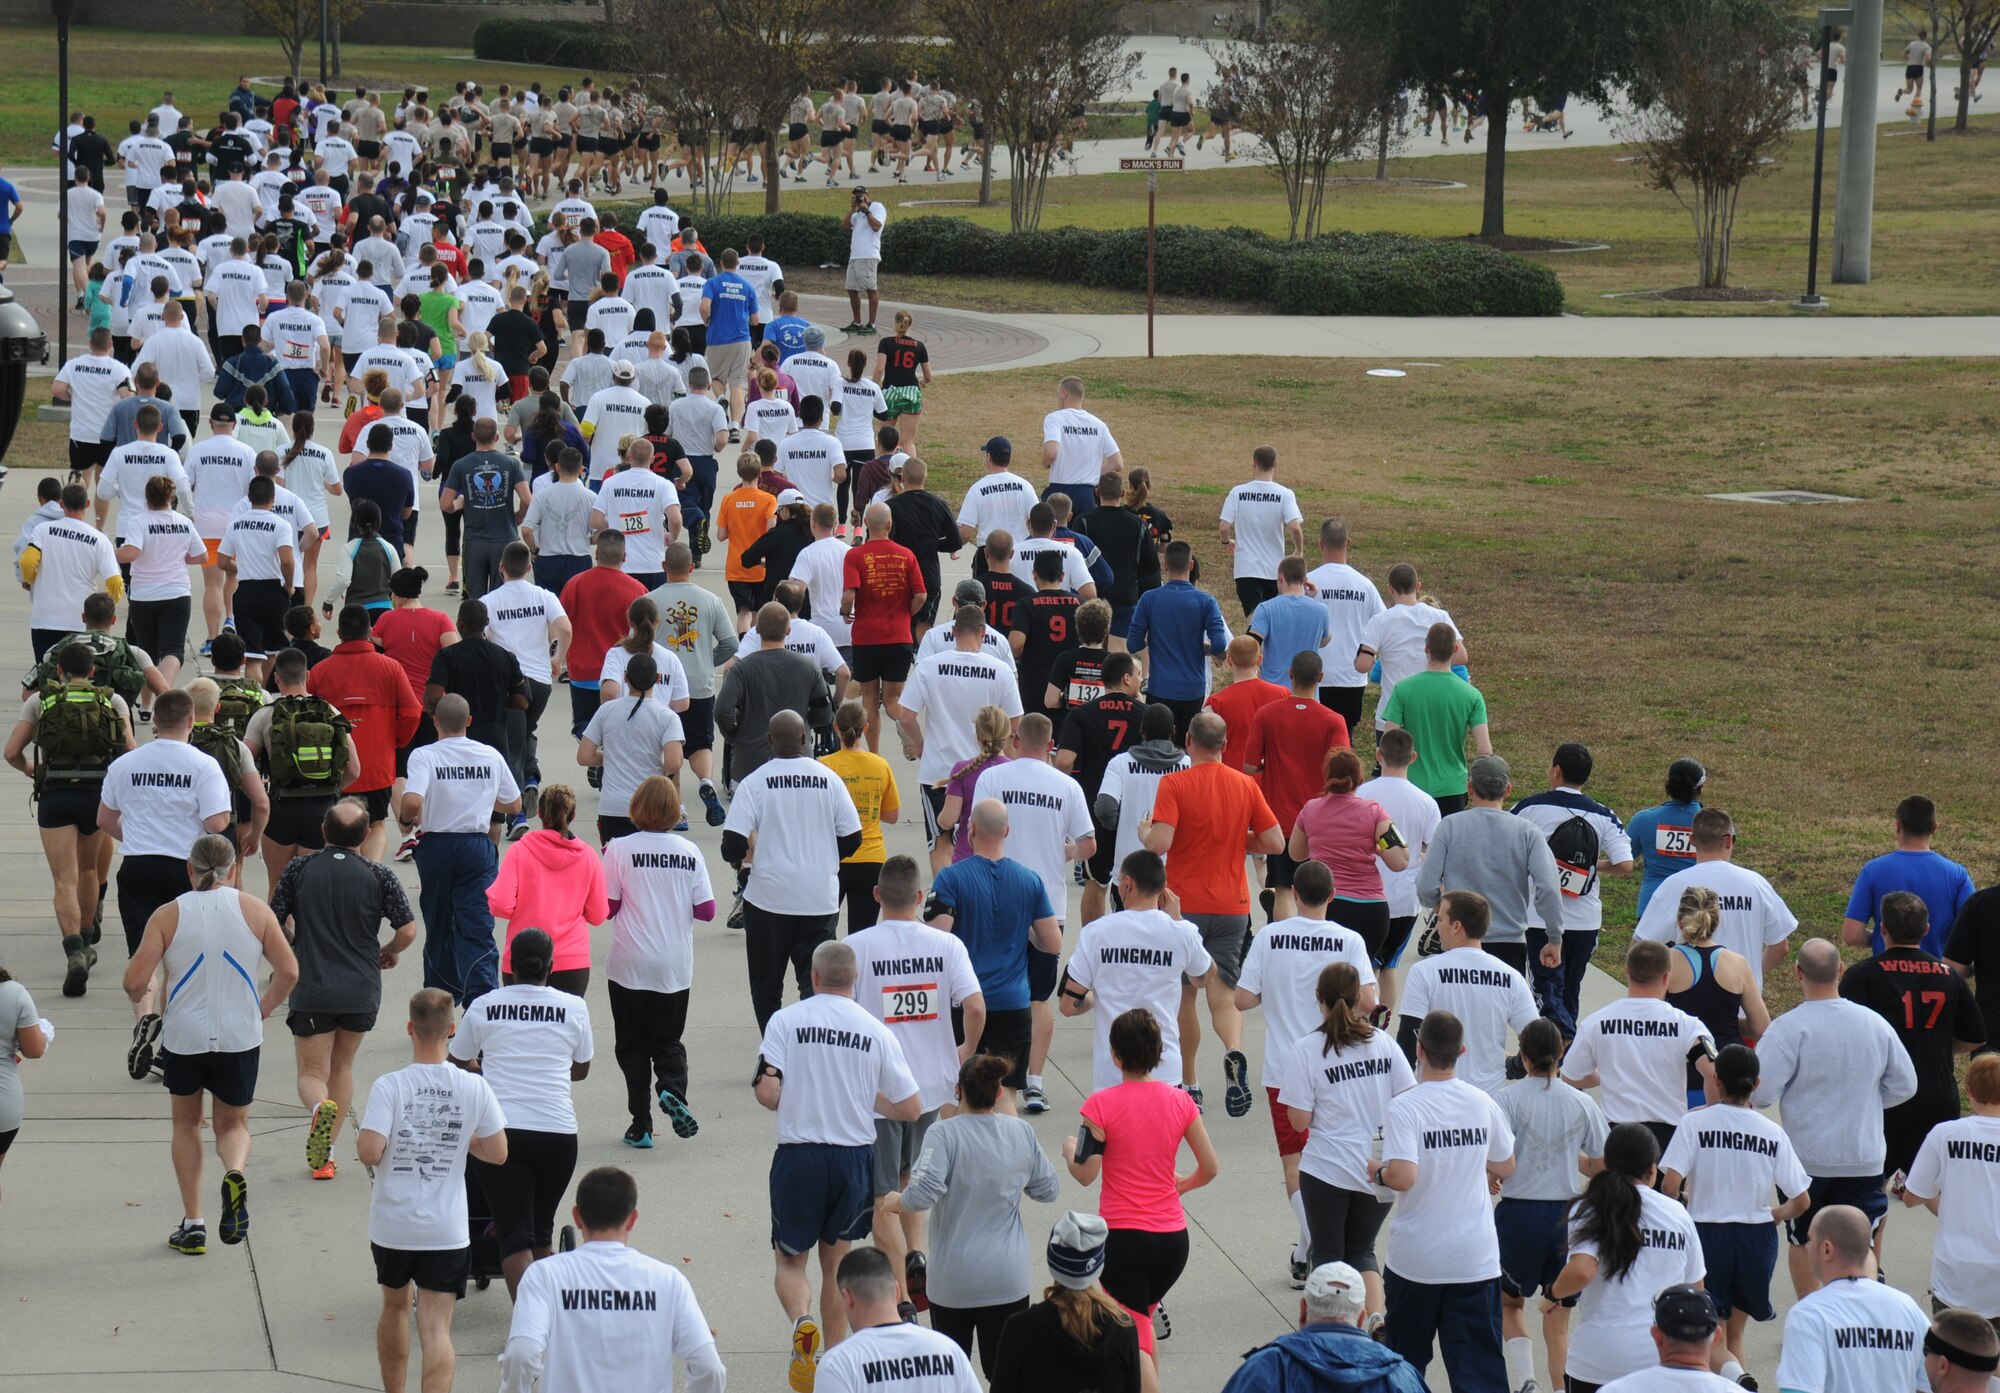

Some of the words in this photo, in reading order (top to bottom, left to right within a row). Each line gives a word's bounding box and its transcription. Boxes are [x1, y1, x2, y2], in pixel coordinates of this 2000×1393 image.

[1132, 160, 1162, 169] MACK'S
[1163, 160, 1180, 169] RUN
[142, 260, 168, 270] WINGMAN
[222, 272, 251, 281] WINGMAN
[351, 297, 378, 306] WINGMAN
[598, 306, 628, 315] WINGMAN
[280, 323, 312, 332] WINGMAN
[290, 346, 302, 356] 36
[367, 358, 402, 367] WINGMAN
[792, 358, 828, 368] WINGMAN
[895, 351, 915, 368] 16
[74, 364, 112, 376] WINGMAN
[842, 385, 876, 398] WINGMAN
[606, 404, 642, 415] WINGMAN
[757, 408, 789, 418] WINGMAN
[1063, 425, 1098, 437] WINGMAN
[124, 454, 166, 464] WINGMAN
[200, 456, 242, 467] WINGMAN
[788, 450, 827, 460] WINGMAN
[614, 488, 655, 498] WINGMAN
[980, 482, 1023, 497] WINGMAN
[1238, 492, 1281, 503] WINGMAN
[148, 524, 190, 535] WINGMAN
[234, 520, 276, 532] WINGMAN
[625, 516, 644, 531] 128
[49, 526, 98, 546] WINGMAN
[992, 581, 1012, 590] UGH
[1032, 597, 1080, 606] BERETTA
[1322, 589, 1366, 602] WINGMAN
[496, 606, 545, 621] WINGMAN
[666, 601, 698, 624] 338
[1049, 615, 1066, 642] 9
[938, 663, 996, 680] WINGMAN
[1078, 685, 1099, 701] 132
[1099, 700, 1132, 711] GOAT
[1108, 720, 1128, 750] 7
[131, 772, 192, 788] WINGMAN
[435, 766, 490, 780] WINGMAN
[765, 776, 828, 790] WINGMAN
[1002, 790, 1062, 811] WINGMAN
[632, 854, 696, 872] WINGMAN
[1270, 934, 1343, 952] WINGMAN
[1100, 948, 1173, 967] WINGMAN
[872, 956, 944, 976] WINGMAN
[1879, 960, 1950, 975] WOMBAT
[1438, 968, 1511, 988] WINGMAN
[893, 991, 928, 1016] 299
[1902, 990, 1946, 1029] 17
[486, 1004, 566, 1023] WINGMAN
[1600, 1019, 1679, 1037] WINGMAN
[796, 1027, 872, 1053] WINGMAN
[1324, 1057, 1392, 1085] WINGMAN
[1423, 1128, 1488, 1149] WINGMAN
[1698, 1130, 1778, 1158] WINGMAN
[1948, 1141, 2000, 1163] WING
[562, 1289, 656, 1311] WINGMAN
[1835, 1327, 1914, 1351] WINGMAN
[862, 1355, 954, 1384] WINGMAN
